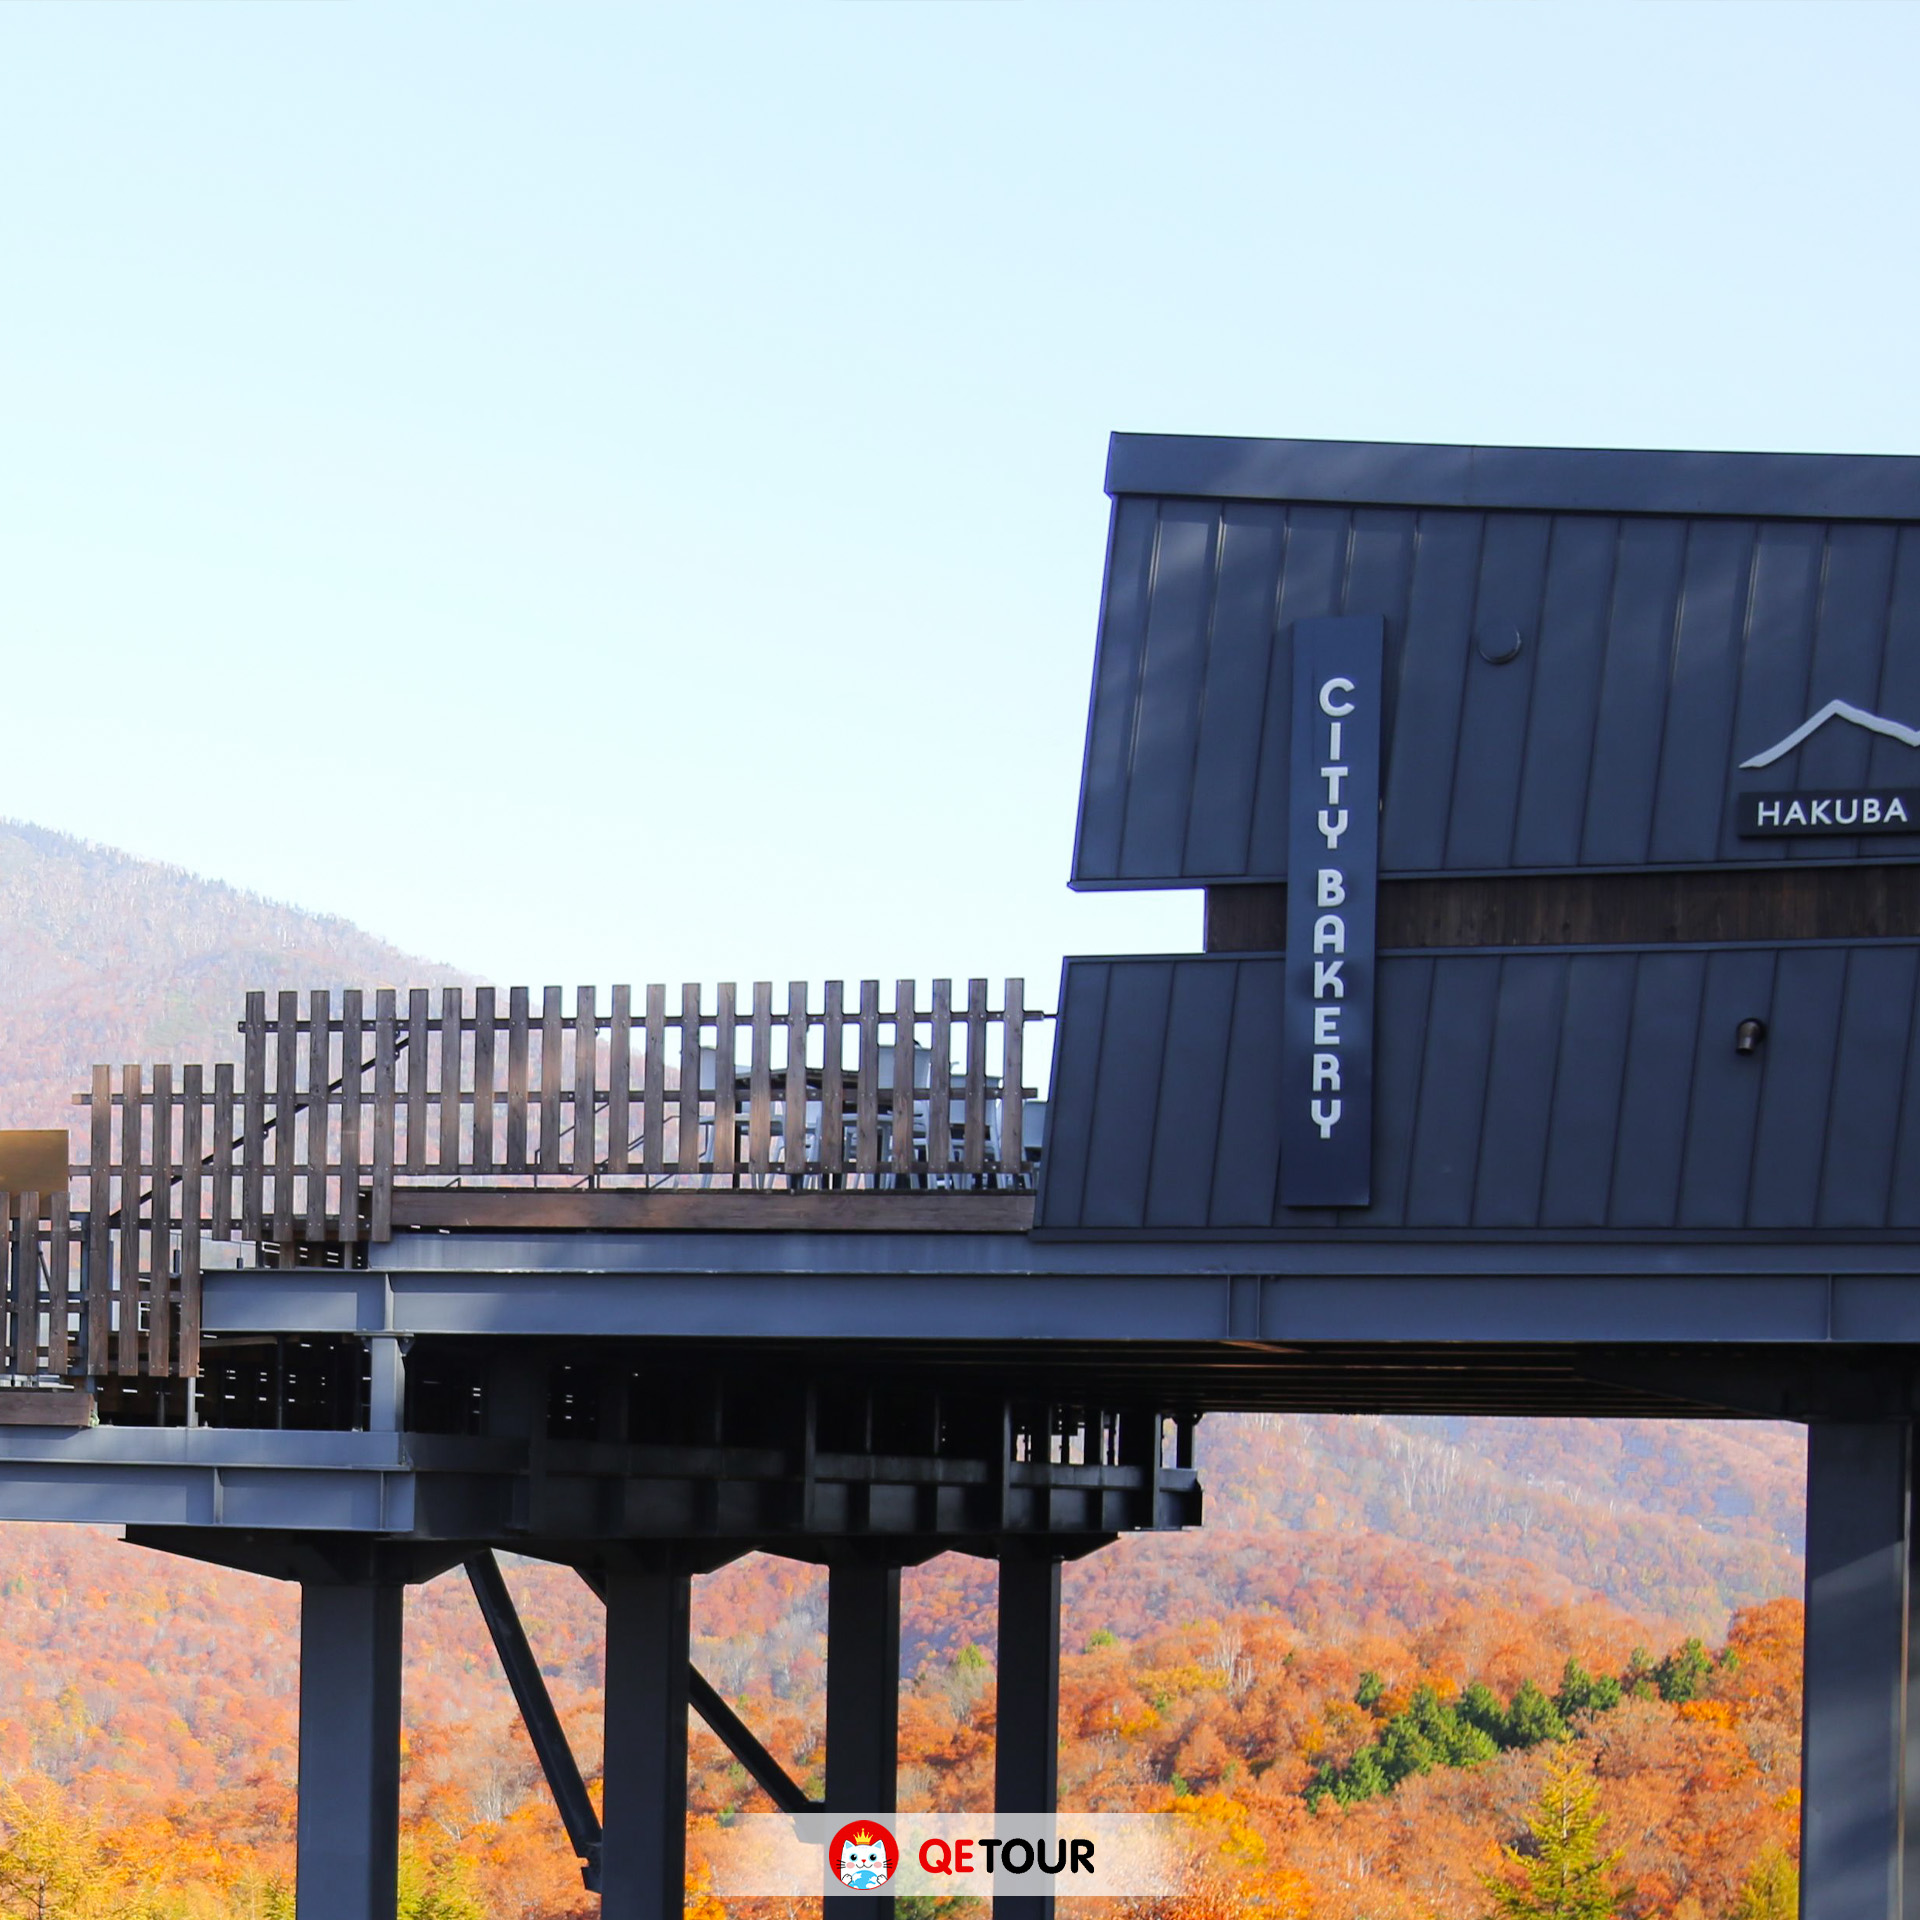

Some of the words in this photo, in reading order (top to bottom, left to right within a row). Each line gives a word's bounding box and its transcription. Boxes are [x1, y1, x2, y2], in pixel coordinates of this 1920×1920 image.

[1317, 677, 1356, 850] CITY
[1757, 797, 1908, 827] HAKUBA
[1310, 868, 1346, 1139] BAKERY
